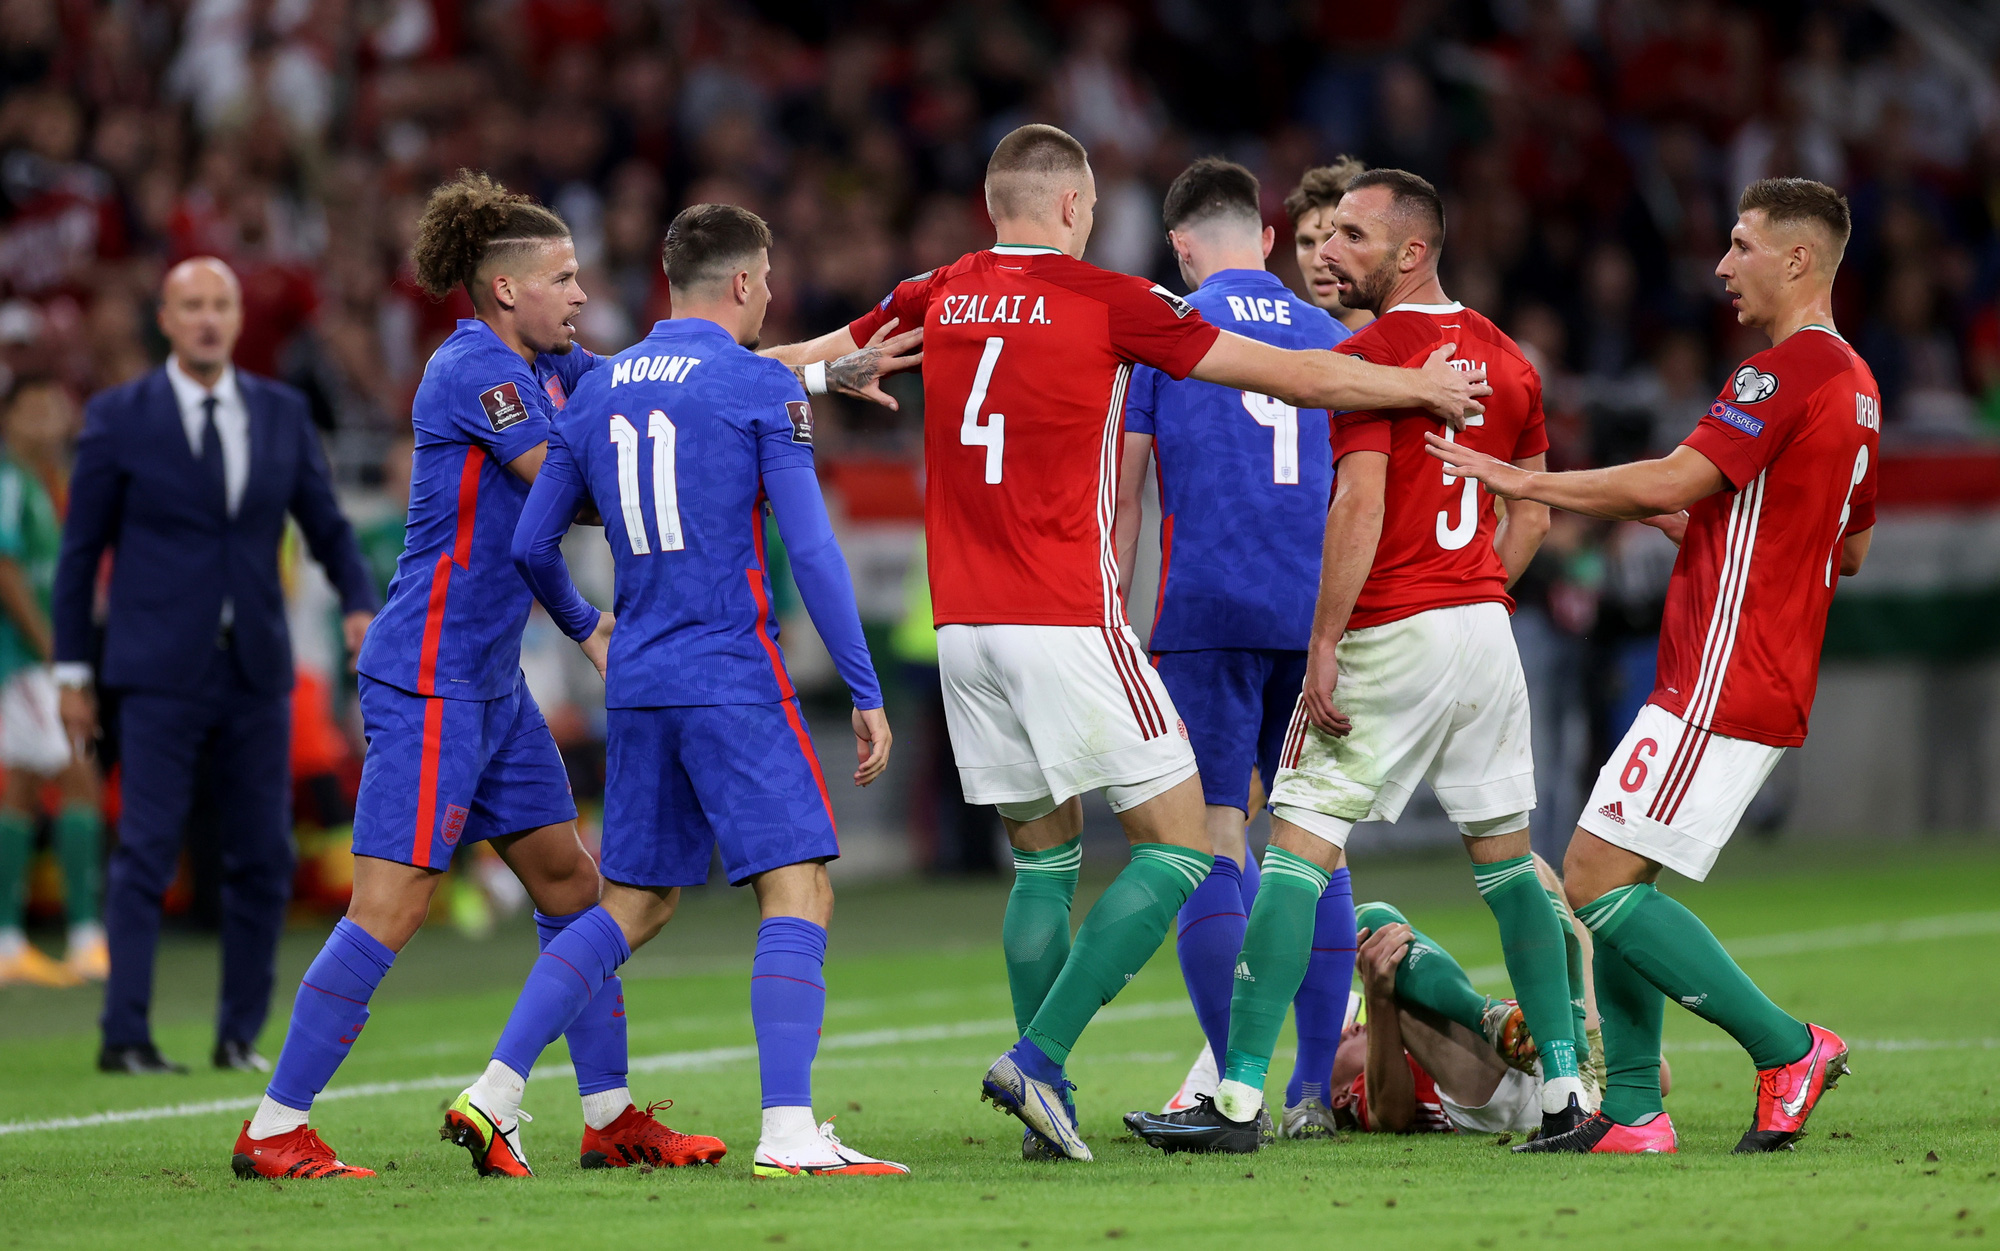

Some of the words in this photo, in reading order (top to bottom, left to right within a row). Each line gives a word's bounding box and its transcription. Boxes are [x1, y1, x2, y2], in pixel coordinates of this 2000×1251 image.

[939, 295, 1026, 325] SZALAI
[1028, 295, 1052, 325] A.
[1225, 295, 1292, 326] RICE
[610, 355, 702, 389] MOUNT
[959, 336, 1005, 485] 4
[1724, 410, 1764, 433] RESPECT
[608, 409, 686, 555] 11
[1619, 737, 1658, 794] 6
[1598, 807, 1626, 826] adidas
[1300, 1125, 1325, 1134] COPA
